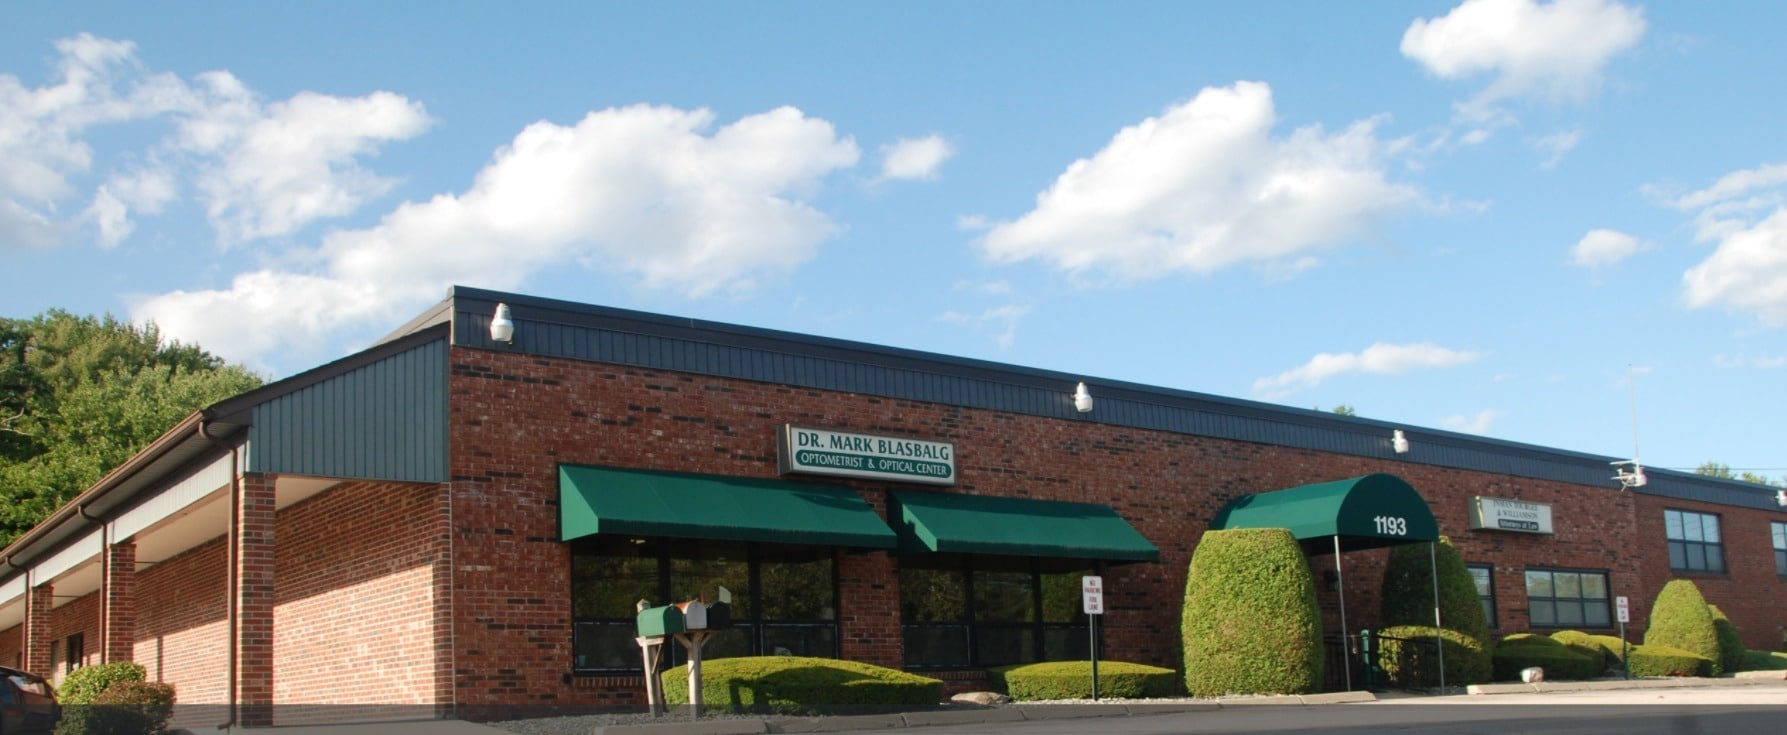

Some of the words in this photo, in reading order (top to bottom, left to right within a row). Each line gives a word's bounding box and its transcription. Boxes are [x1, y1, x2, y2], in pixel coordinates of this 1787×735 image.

[798, 431, 825, 448] DR.
[830, 434, 873, 452] MARK
[878, 439, 949, 460] BLASBALG
[801, 452, 863, 468] OPTOMETRIST
[867, 458, 875, 469] &
[879, 459, 914, 473] OPTICAL
[917, 463, 948, 476] CENTER
[1373, 515, 1407, 536] 1193
